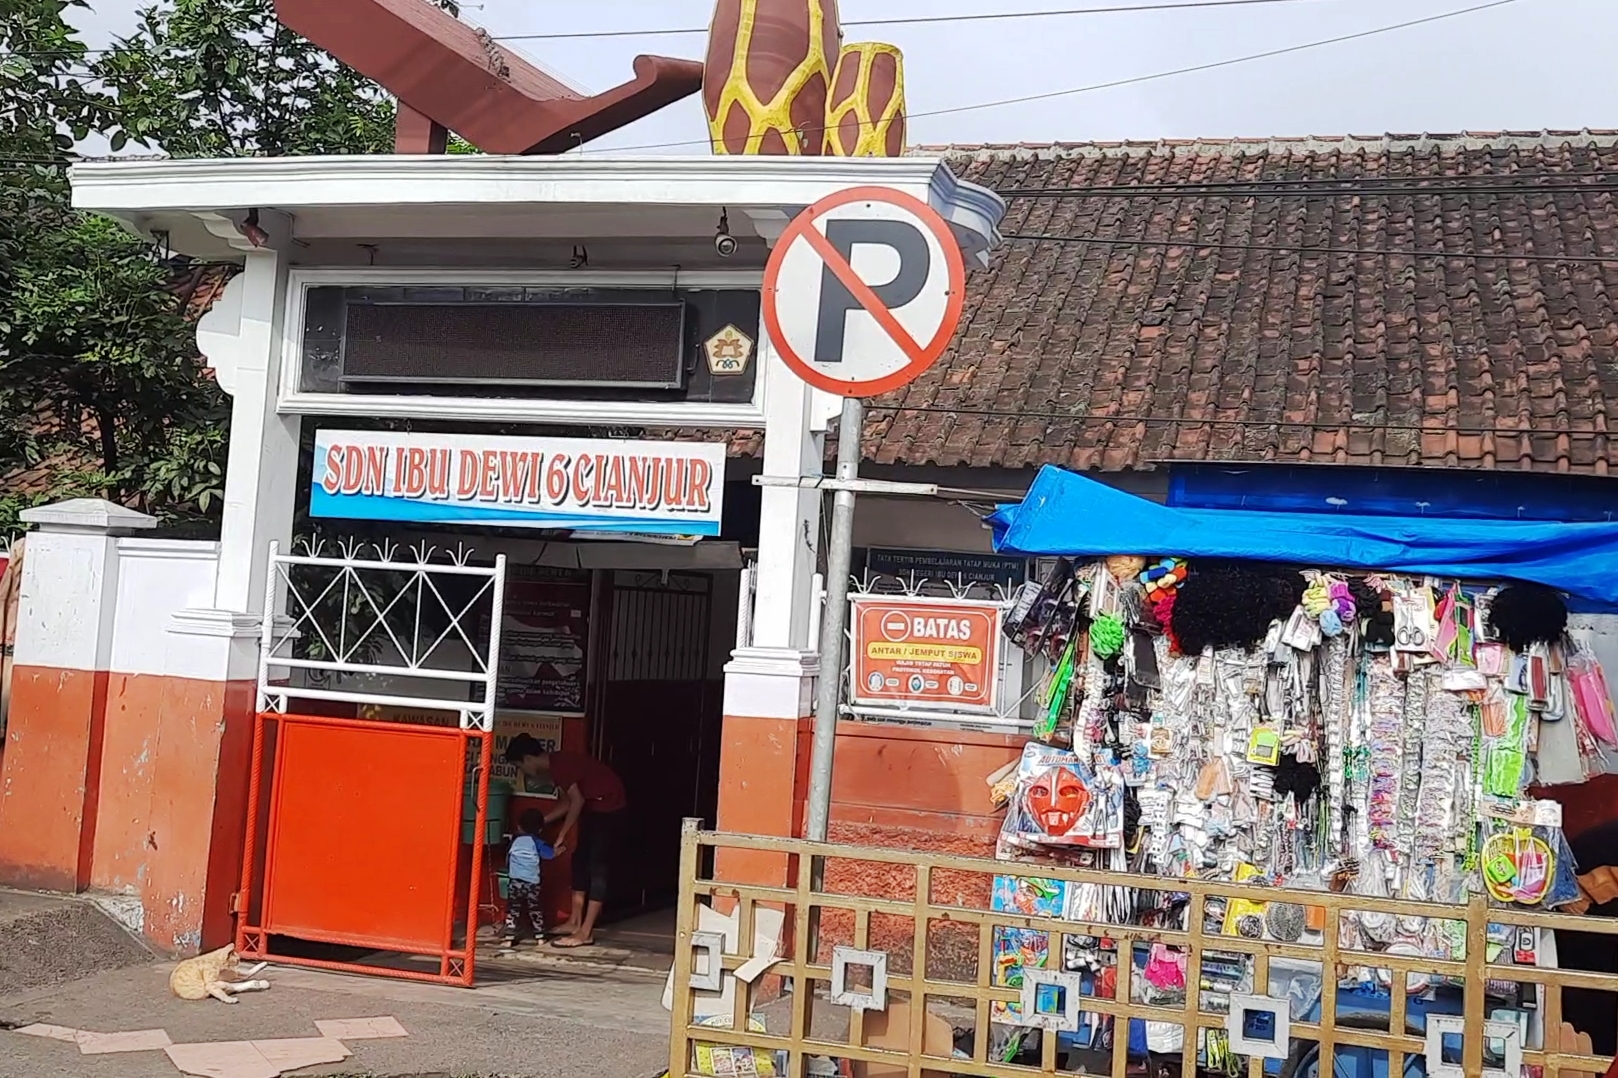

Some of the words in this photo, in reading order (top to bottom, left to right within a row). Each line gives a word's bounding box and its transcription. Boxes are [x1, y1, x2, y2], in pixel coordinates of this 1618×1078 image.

[814, 219, 930, 362] P
[322, 443, 388, 496] SDN
[393, 445, 450, 499] IBU
[456, 447, 543, 501] DEWI
[546, 452, 571, 506] 6
[573, 452, 714, 513] CIANJUR
[913, 617, 971, 640] BATAS
[871, 646, 902, 655] ANTAR
[909, 648, 946, 657] JEMPUT
[948, 651, 977, 660] SISWA
